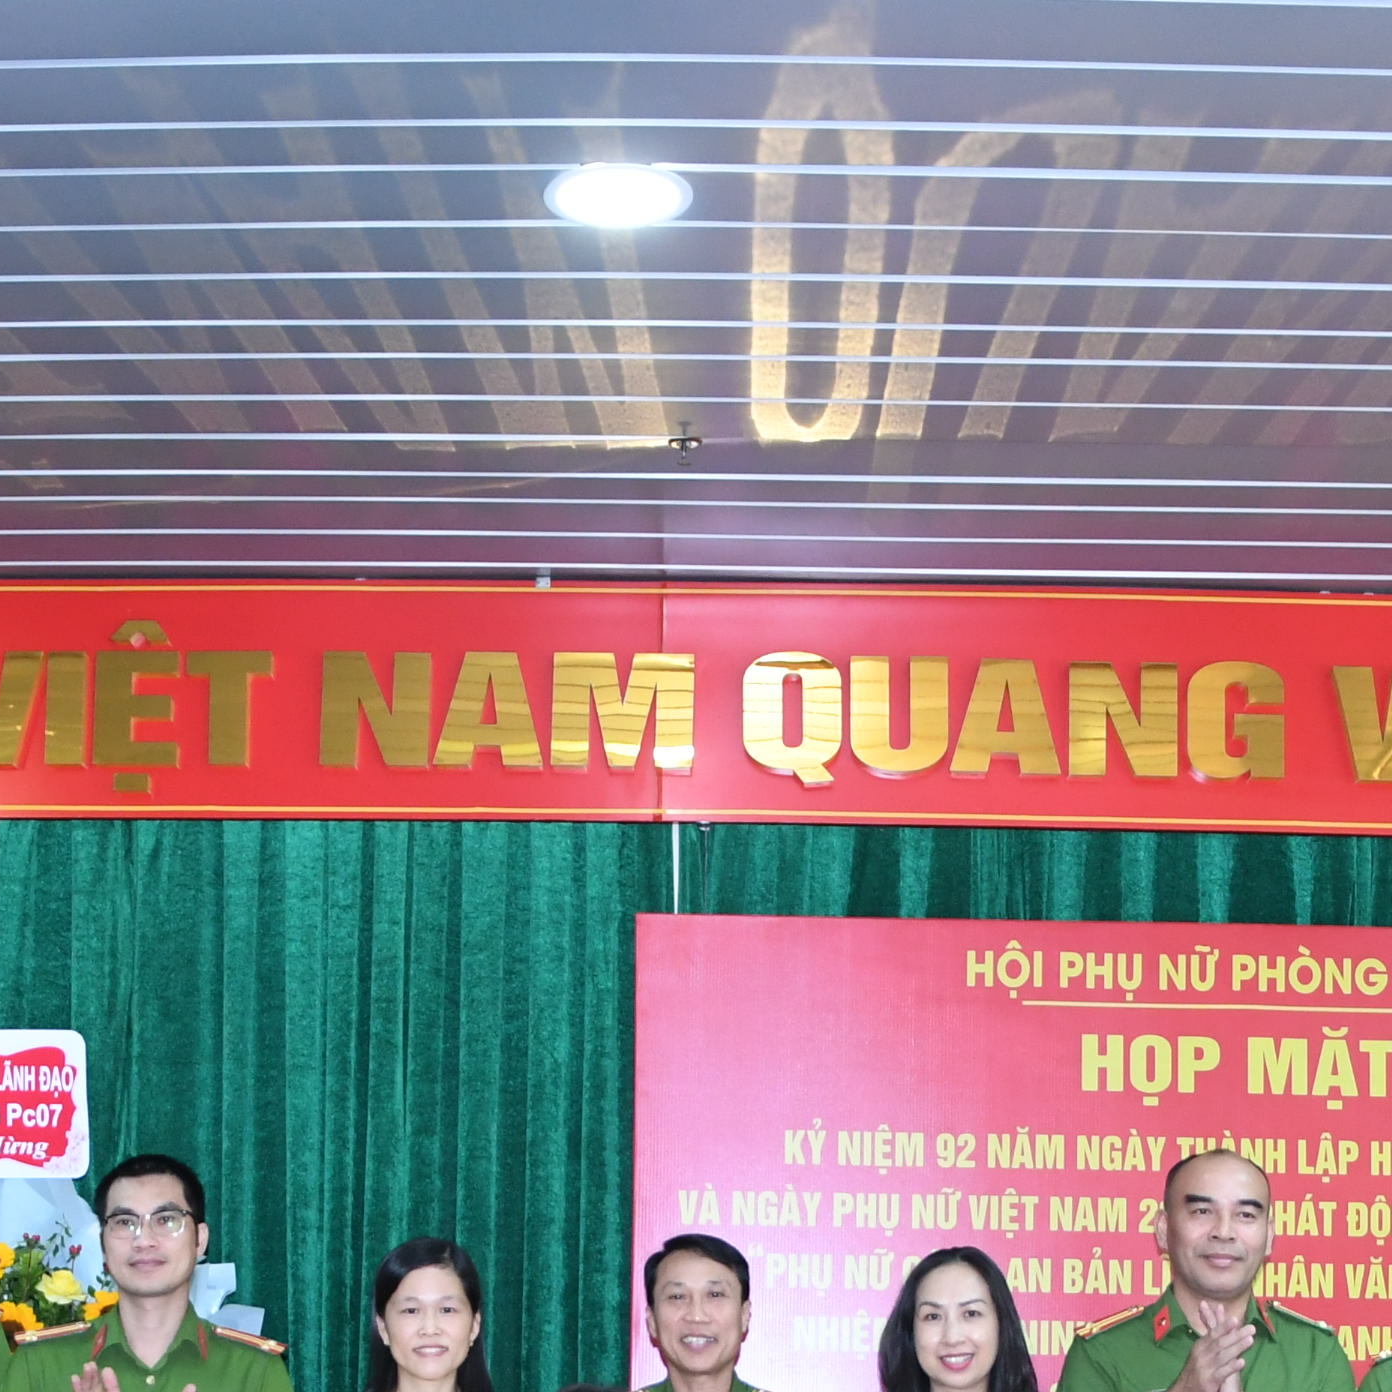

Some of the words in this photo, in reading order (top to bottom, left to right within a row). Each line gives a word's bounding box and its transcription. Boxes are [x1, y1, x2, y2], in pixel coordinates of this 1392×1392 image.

[320, 652, 695, 771] NAM
[741, 653, 1286, 786] QUANG
[966, 940, 1042, 999] HỘI
[1059, 952, 1143, 1001] PHỤ
[1159, 945, 1219, 991] NỮ
[1232, 945, 1388, 995] PHÒNG
[39, 1064, 74, 1098] ĐẠO
[1081, 1033, 1221, 1106] HỌP
[784, 1118, 827, 1165] KỶ
[837, 1124, 924, 1174] NIỆM
[936, 1133, 976, 1168] 92
[987, 1126, 1065, 1169] NĂM
[1076, 1129, 1166, 1172] NGÀY
[1297, 1132, 1359, 1183] LẬP
[678, 1182, 721, 1225] VÀ
[731, 1184, 822, 1227] NGÀY
[832, 1193, 900, 1237] PHỤ
[912, 1187, 962, 1230] NỮ
[969, 1189, 1039, 1238] VIỆT
[1049, 1196, 1127, 1233] NAM
[1269, 1193, 1336, 1236] HÁT
[844, 1248, 895, 1291] NỮ
[1008, 1257, 1051, 1293] AN
[1063, 1247, 1132, 1295] BẢN
